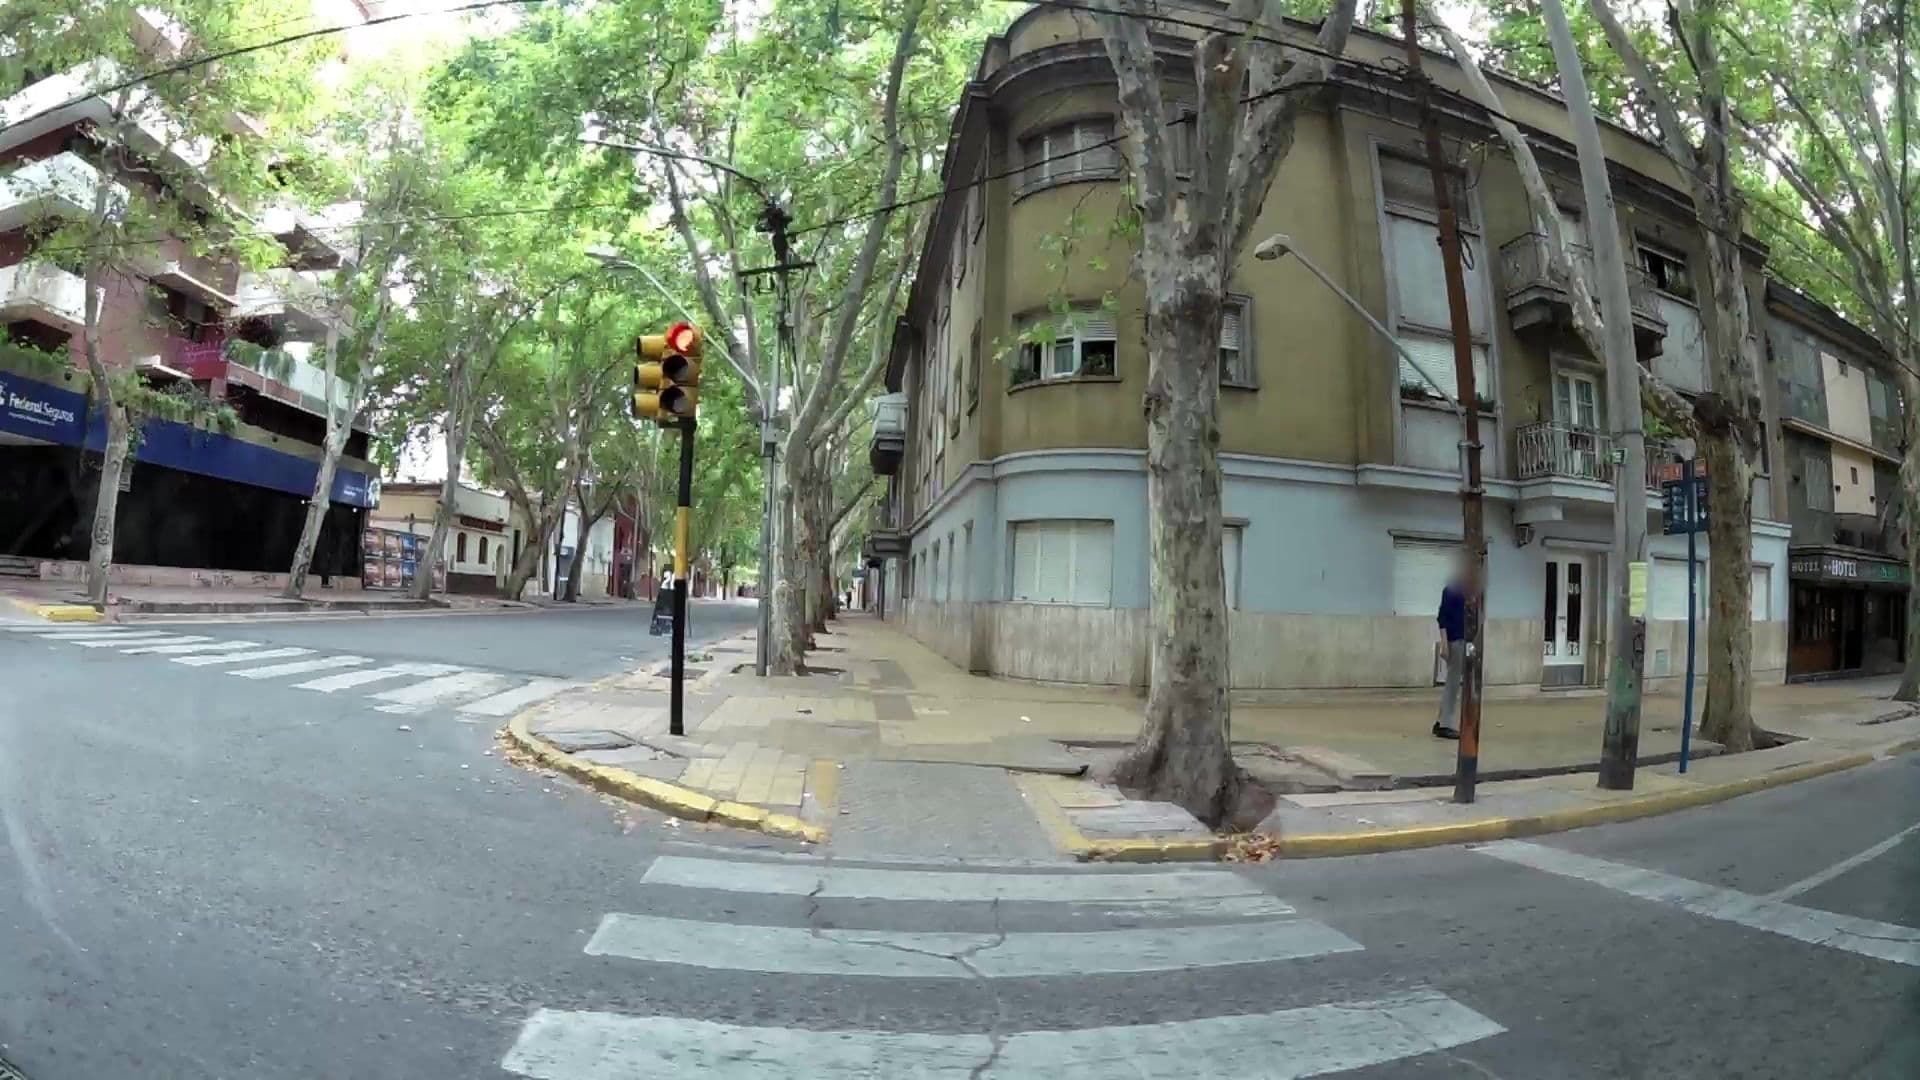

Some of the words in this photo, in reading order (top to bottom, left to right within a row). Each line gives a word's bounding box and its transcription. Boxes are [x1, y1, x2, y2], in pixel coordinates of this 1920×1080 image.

[9, 392, 42, 413] Federal
[43, 402, 74, 422] Seguros
[1792, 561, 1820, 572] HOTEL
[1831, 560, 1857, 577] HOTEL
